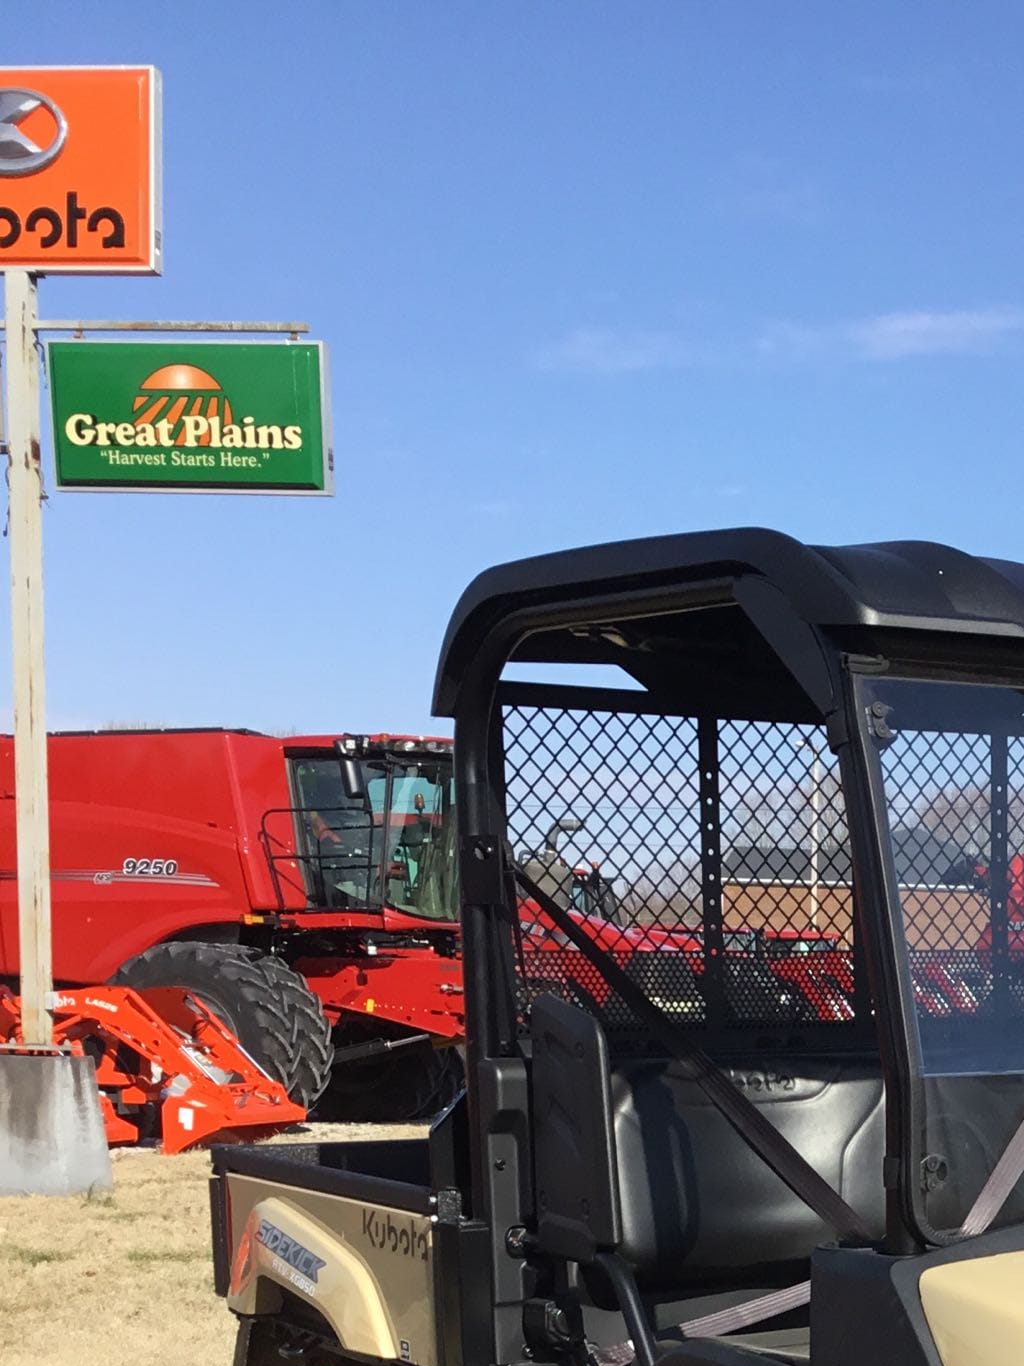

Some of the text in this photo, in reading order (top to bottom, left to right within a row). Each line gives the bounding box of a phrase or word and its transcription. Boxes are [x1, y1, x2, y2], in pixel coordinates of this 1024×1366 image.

[65, 413, 302, 449] Great Plains
[171, 451, 215, 467] Starts
[123, 858, 178, 876] 9250
[255, 1219, 327, 1284] SIDEKICK
[362, 1208, 428, 1261] Kubota
